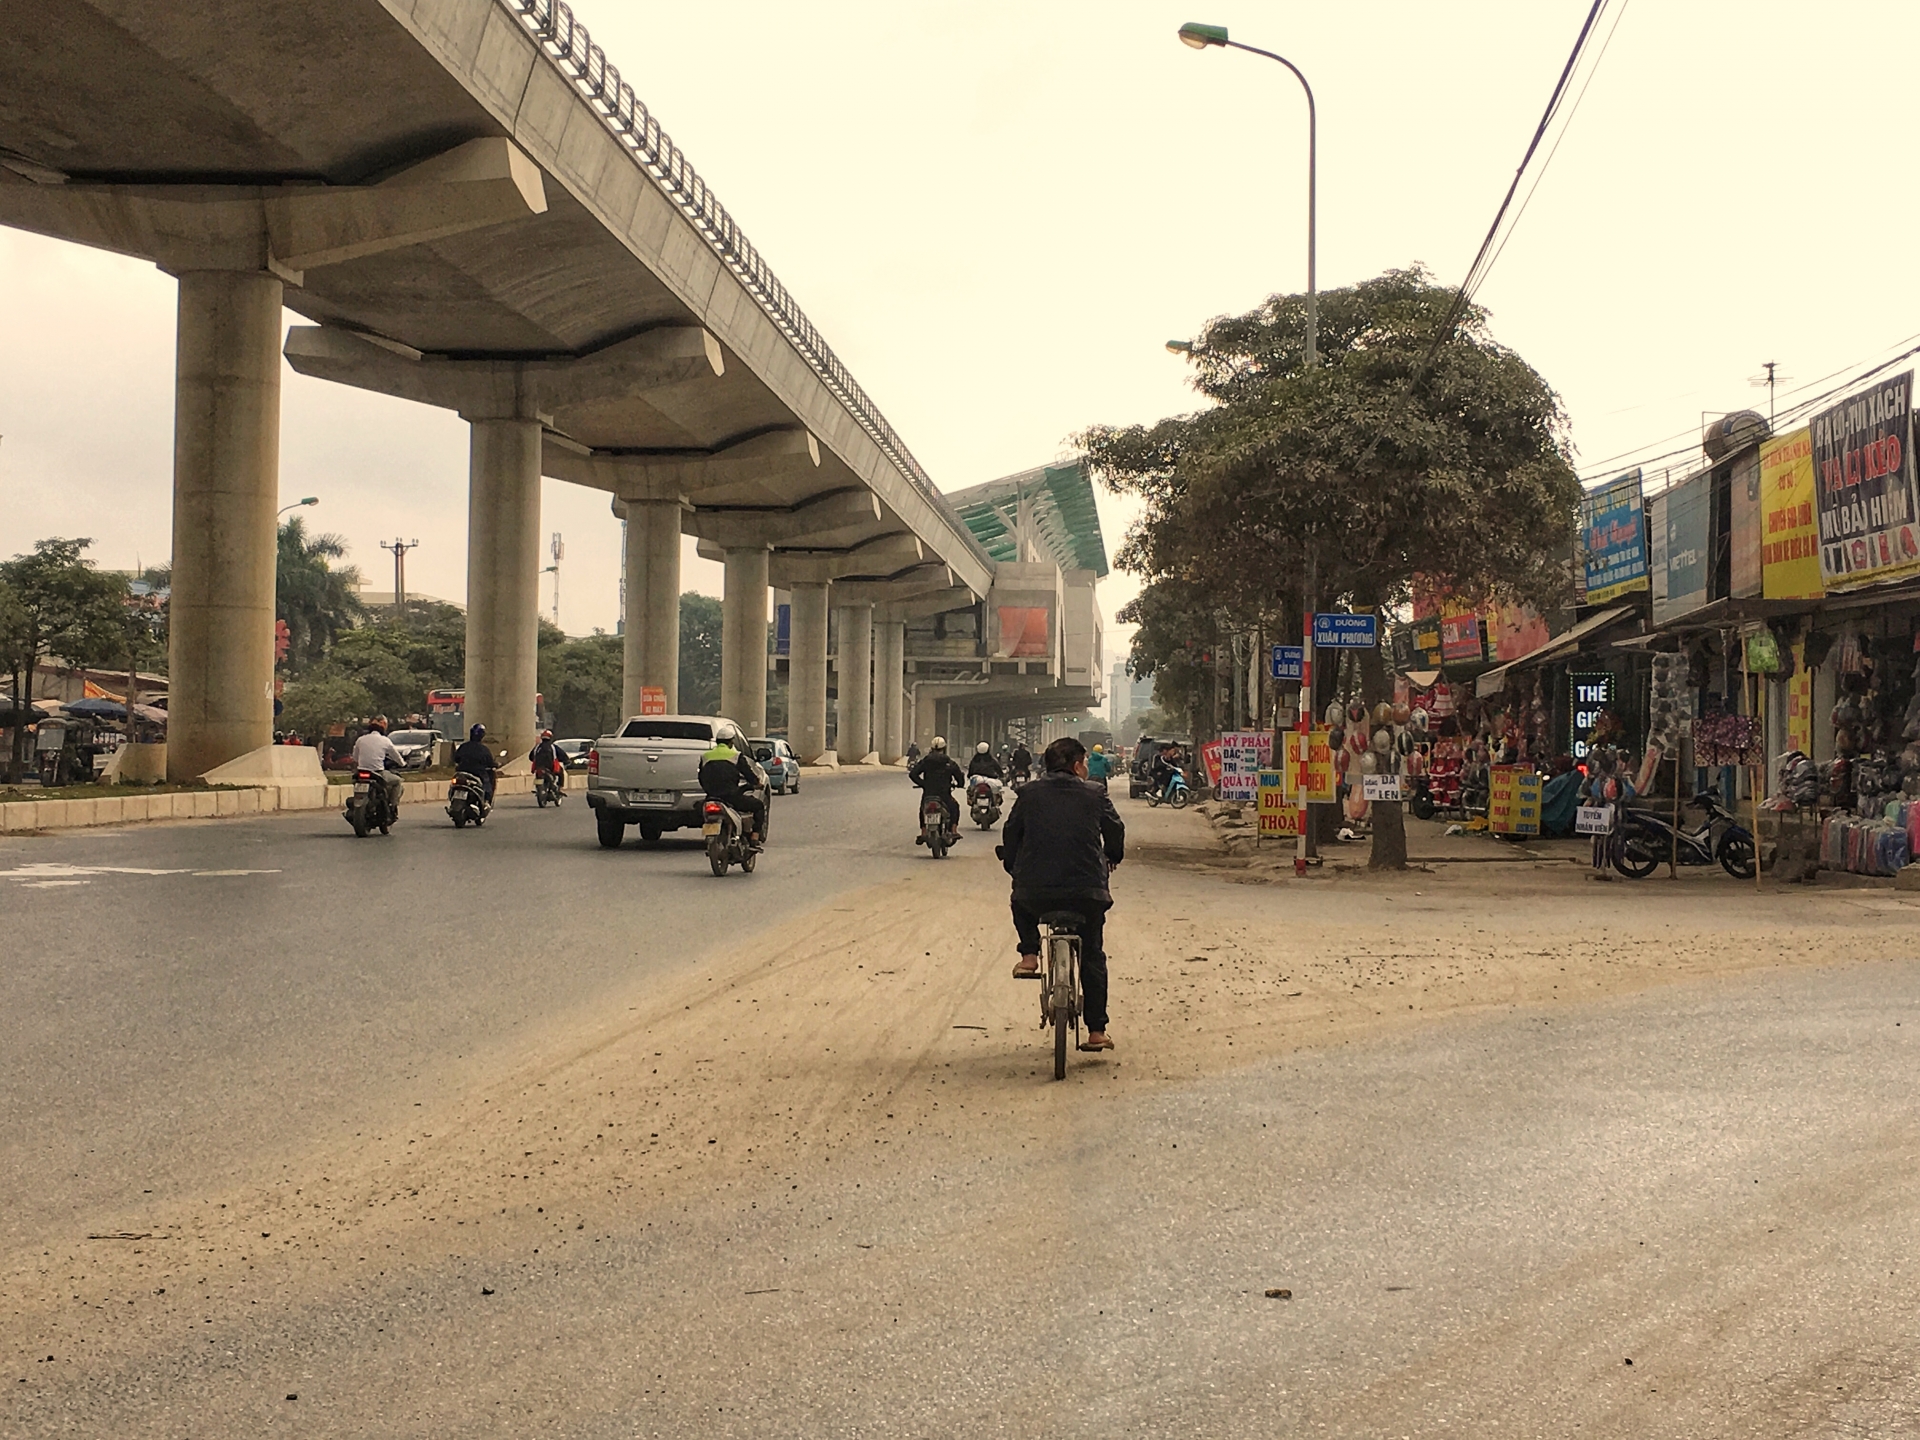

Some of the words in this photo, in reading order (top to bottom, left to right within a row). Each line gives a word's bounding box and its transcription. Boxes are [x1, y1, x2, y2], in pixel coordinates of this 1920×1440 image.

[1868, 383, 1906, 427] XÁCH
[1846, 448, 1861, 488] LI
[1841, 493, 1868, 535] BẢO
[1335, 618, 1367, 626] ĐƯỜNG
[1317, 630, 1338, 644] XUÂN
[1341, 632, 1373, 644] PHƯƠNG
[1577, 678, 1609, 702] THẾ
[1223, 734, 1238, 747] MỸ
[1223, 747, 1241, 761] ĐẶC
[1223, 762, 1237, 774] TRỊ
[1222, 773, 1242, 788] QUÀ
[1245, 773, 1257, 789] TẶ
[1260, 774, 1280, 787] MUA
[1382, 775, 1396, 785] DA
[1379, 790, 1399, 800] LEN
[1260, 815, 1299, 834] THOẠ
